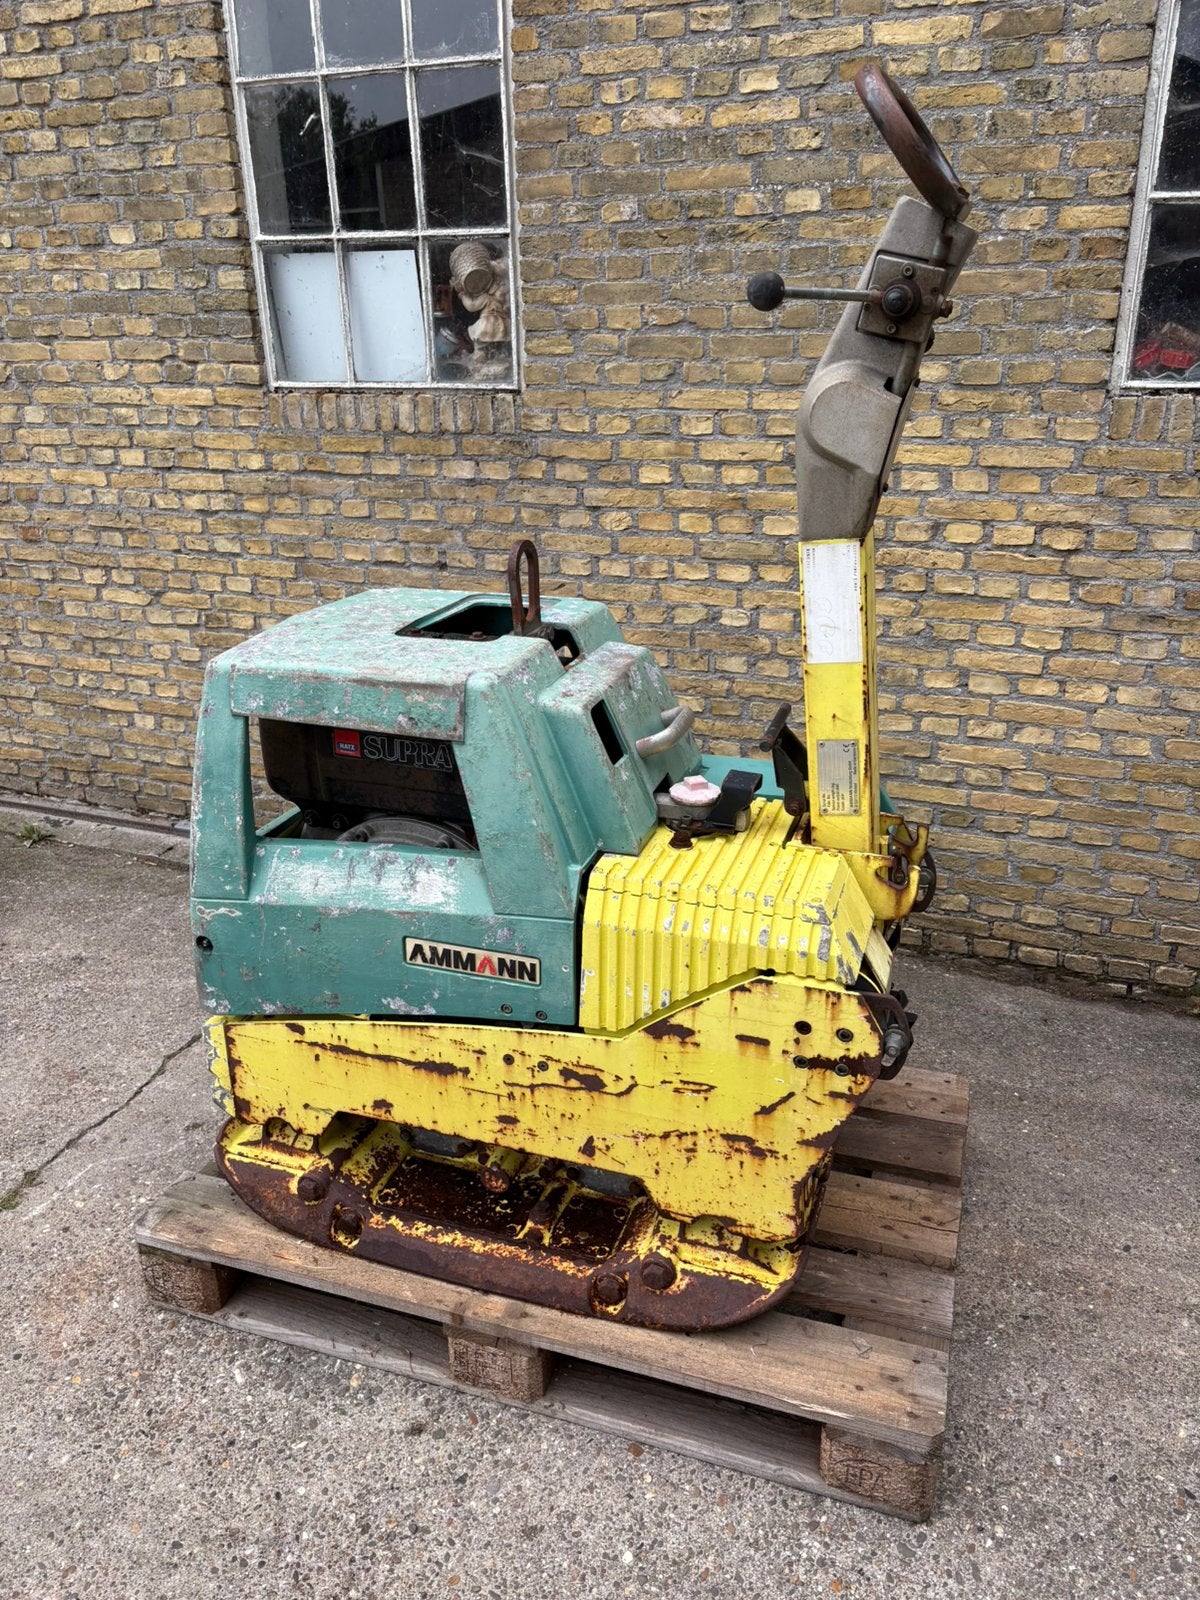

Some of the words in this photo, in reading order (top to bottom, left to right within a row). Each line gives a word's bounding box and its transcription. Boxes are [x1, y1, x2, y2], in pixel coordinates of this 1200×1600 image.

[339, 742, 355, 751] HATZ
[363, 734, 453, 769] SUPRA
[409, 943, 537, 982] AMMANN
